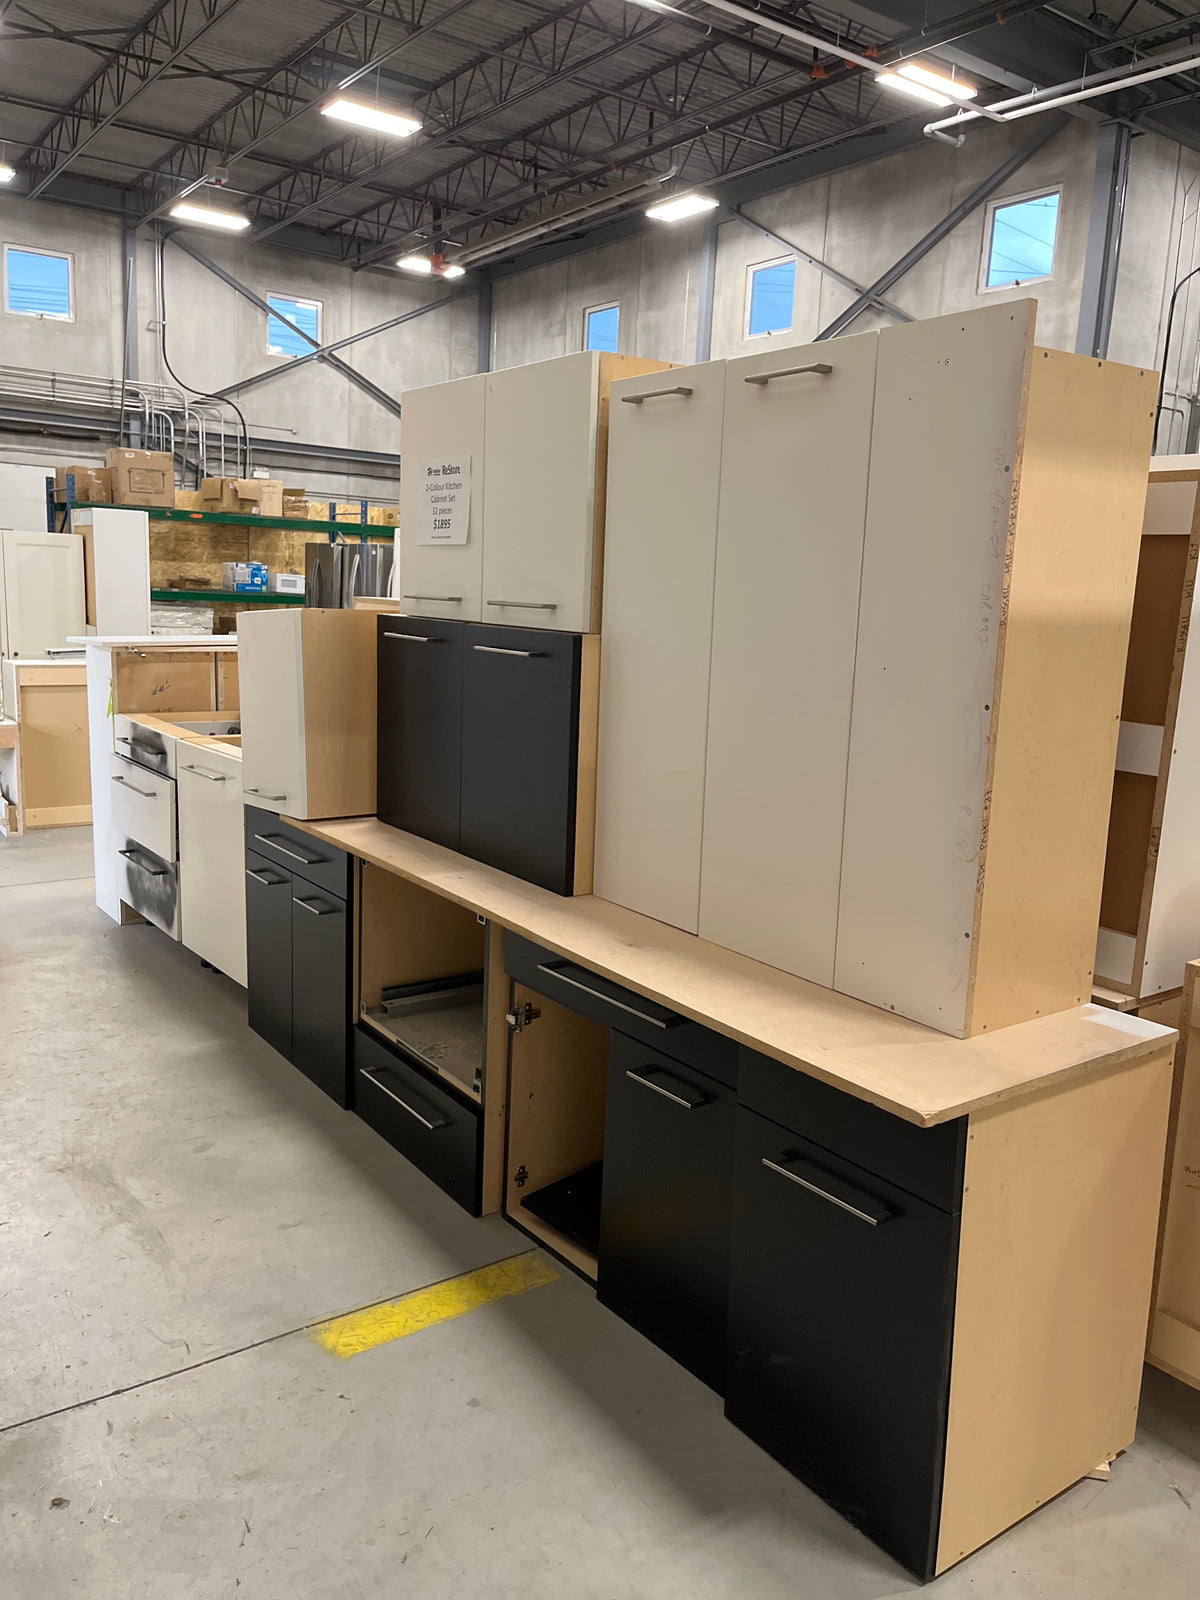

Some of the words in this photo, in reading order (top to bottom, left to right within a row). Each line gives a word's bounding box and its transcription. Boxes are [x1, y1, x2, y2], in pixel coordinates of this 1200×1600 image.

[442, 464, 460, 475] ReStore
[426, 482, 444, 492] 2-Colour
[446, 482, 462, 490] Kitchen
[430, 495, 448, 503] Cabinet
[438, 507, 452, 516] pieces
[433, 518, 451, 530] $1895
